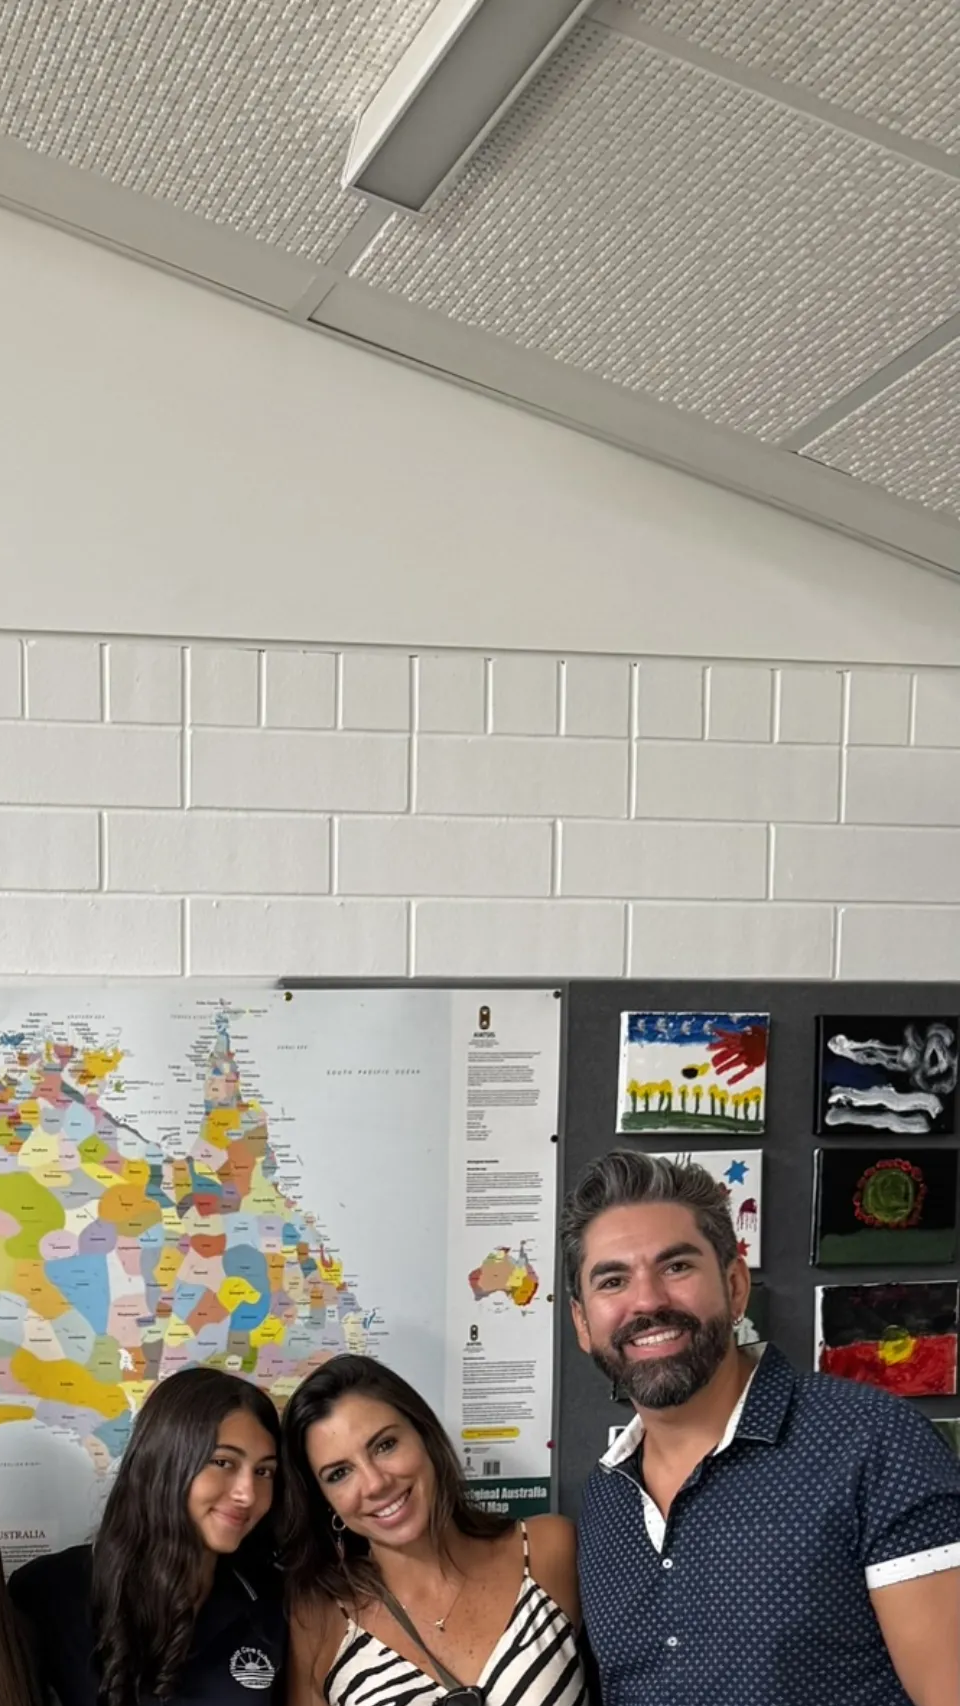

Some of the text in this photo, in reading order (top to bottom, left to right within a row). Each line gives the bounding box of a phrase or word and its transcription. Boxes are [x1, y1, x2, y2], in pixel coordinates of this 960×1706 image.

[463, 1486, 547, 1501] riginal Australia
[487, 1501, 509, 1514] Map
[0, 1529, 46, 1540] USTRALIA
